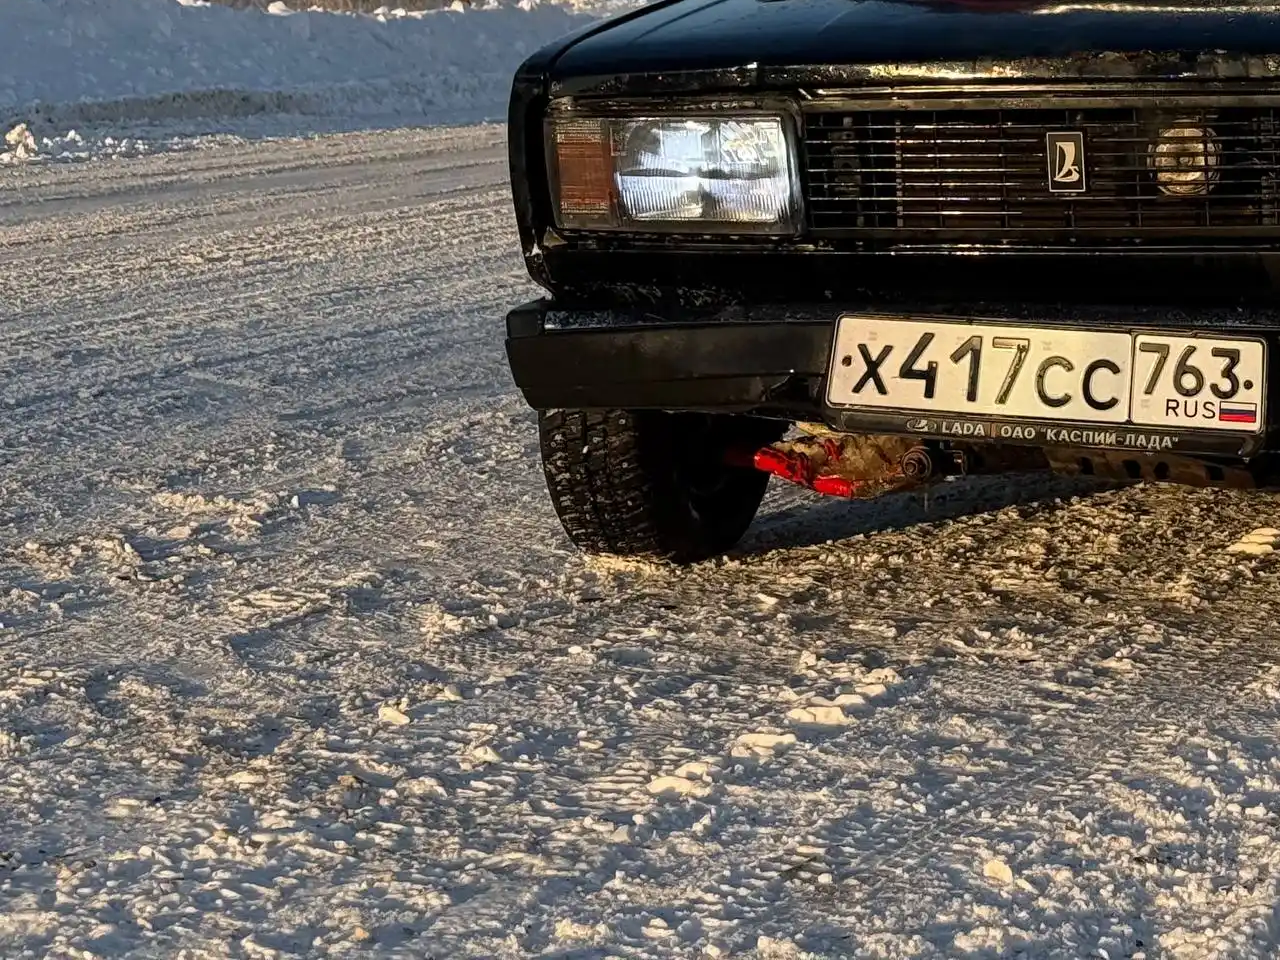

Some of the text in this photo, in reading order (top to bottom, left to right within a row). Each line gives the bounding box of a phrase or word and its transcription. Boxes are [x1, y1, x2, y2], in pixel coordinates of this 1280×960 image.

[1139, 342, 1240, 399] 763
[1165, 398, 1216, 419] RUS
[942, 423, 985, 437] LADA
[1000, 425, 1036, 439] ОАО
